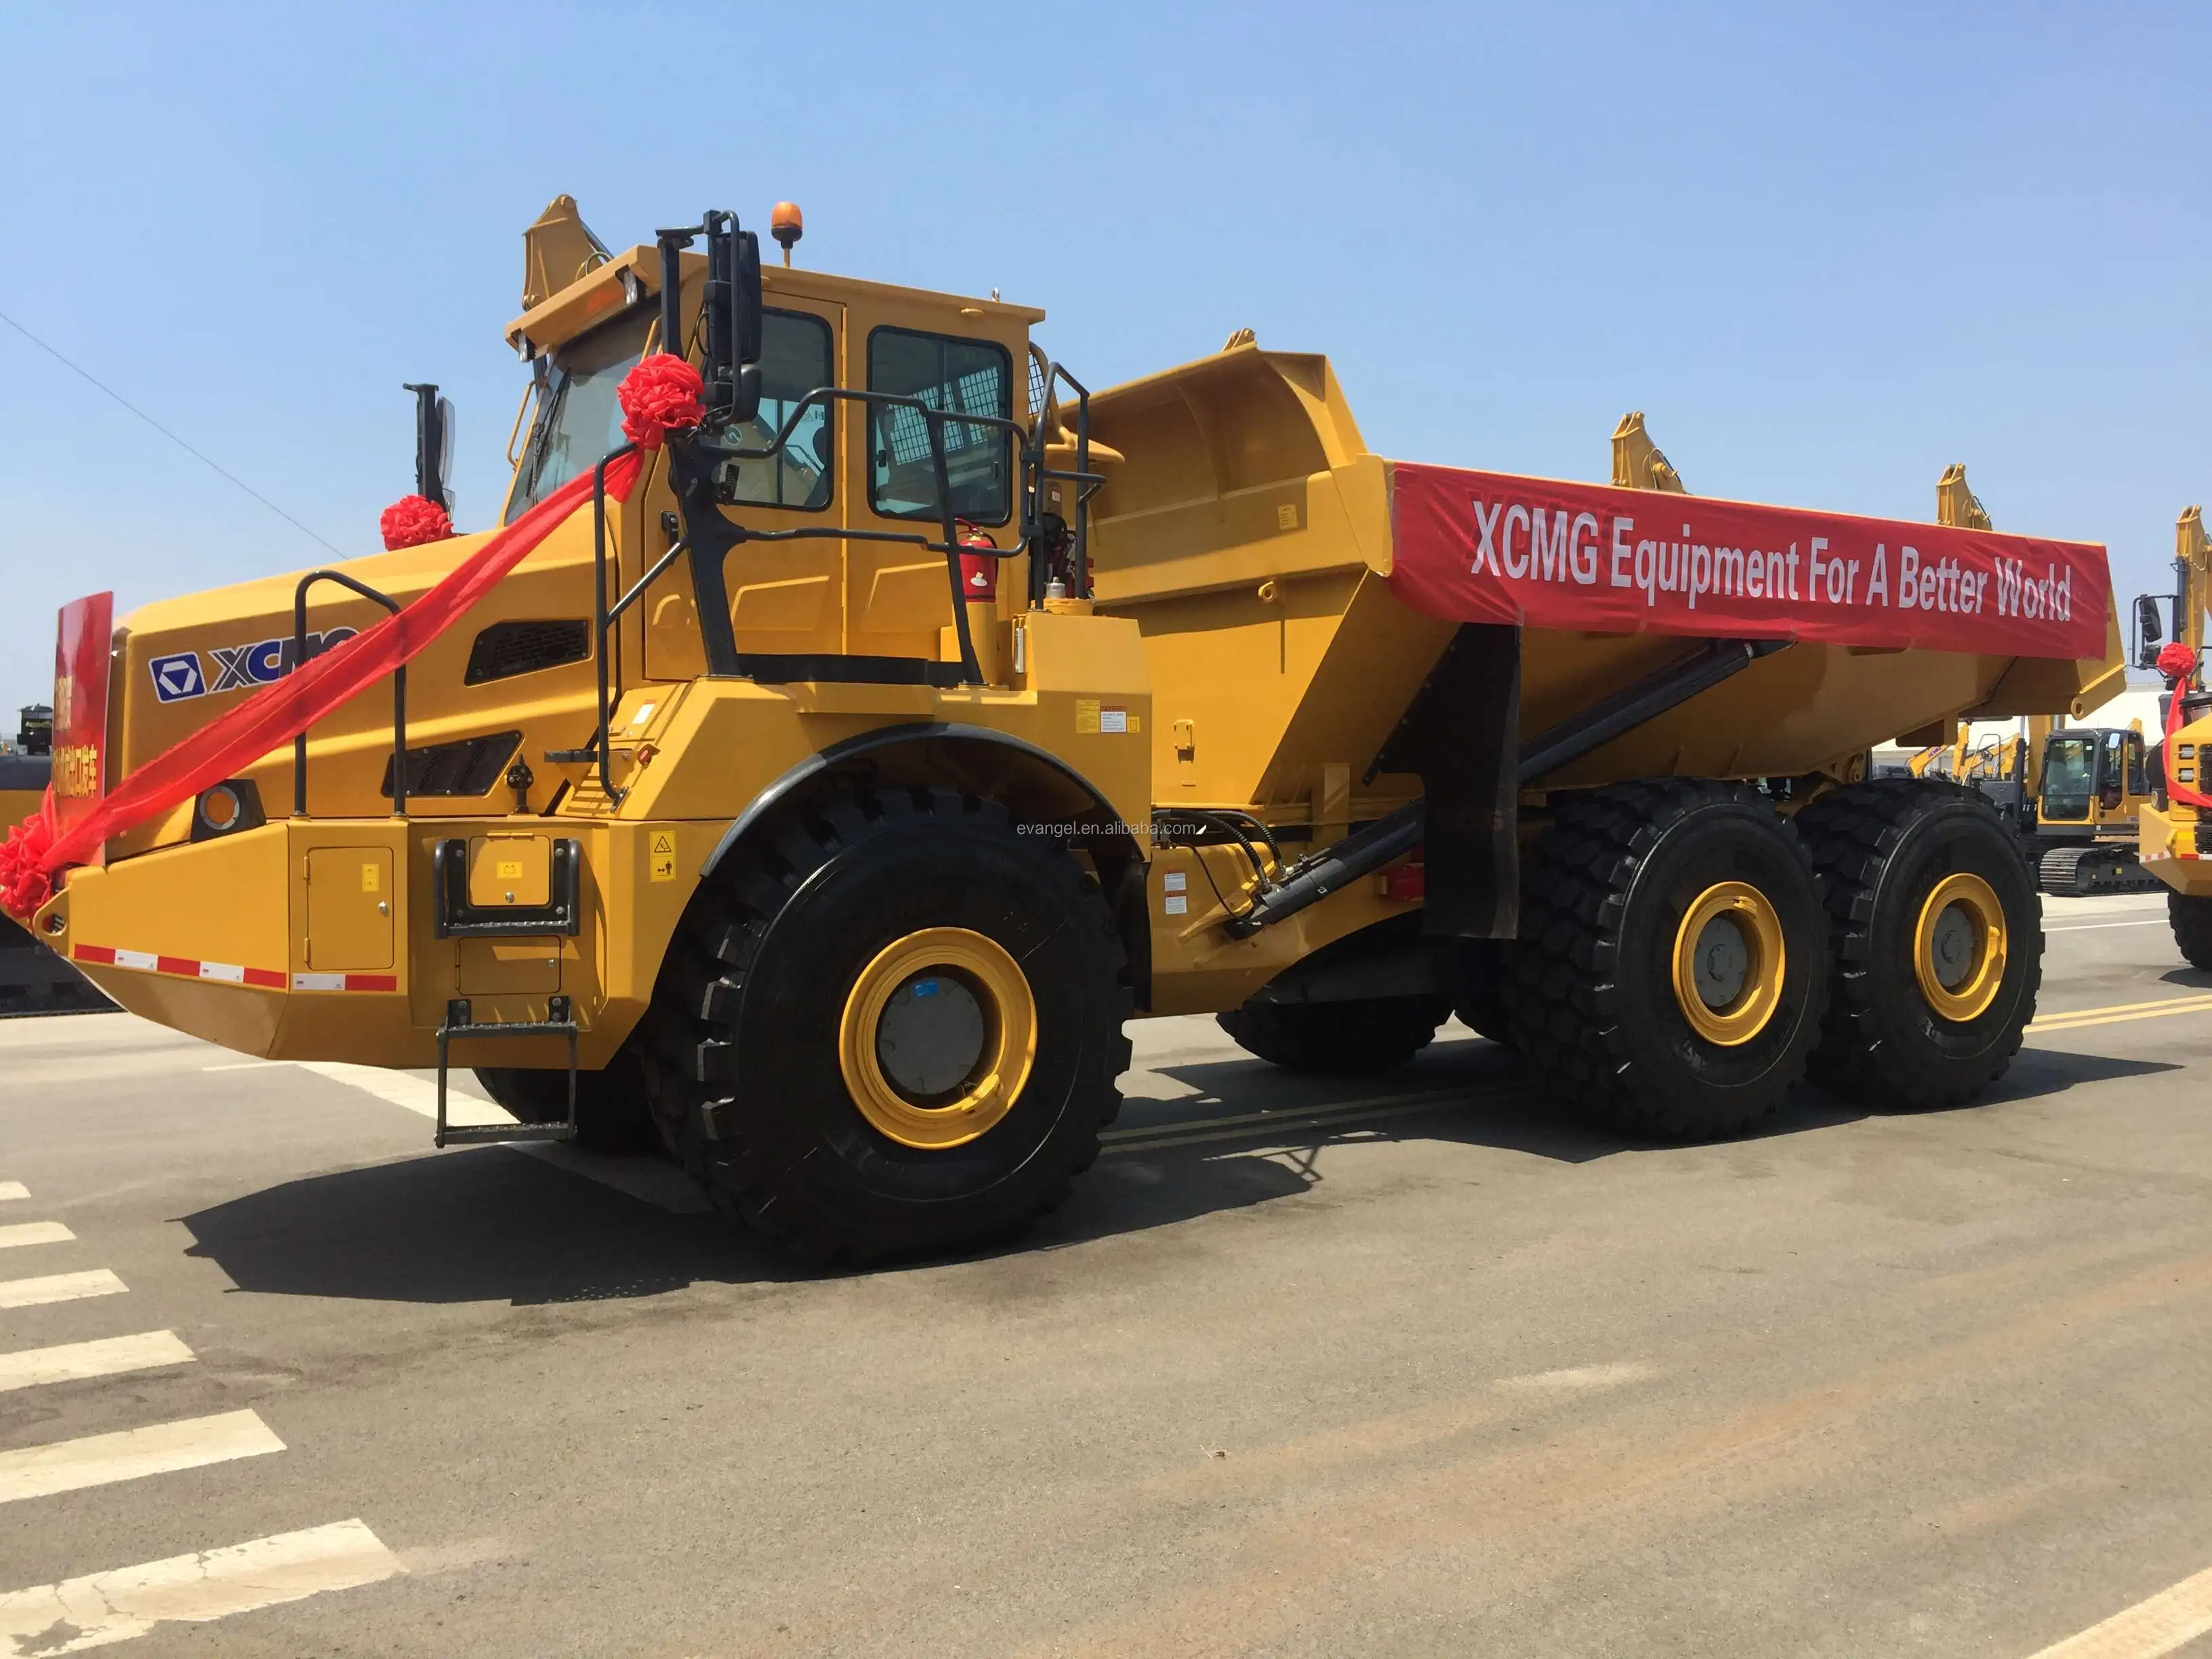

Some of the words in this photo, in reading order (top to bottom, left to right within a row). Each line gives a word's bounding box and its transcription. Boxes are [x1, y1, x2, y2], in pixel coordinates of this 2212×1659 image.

[1471, 501, 1598, 585] XCMG
[1611, 516, 1799, 609] Equipment
[1810, 537, 1859, 605] For
[1866, 544, 1888, 607] A
[1899, 546, 1988, 614] Better
[1995, 556, 2071, 621] World
[207, 626, 361, 694] XCM
